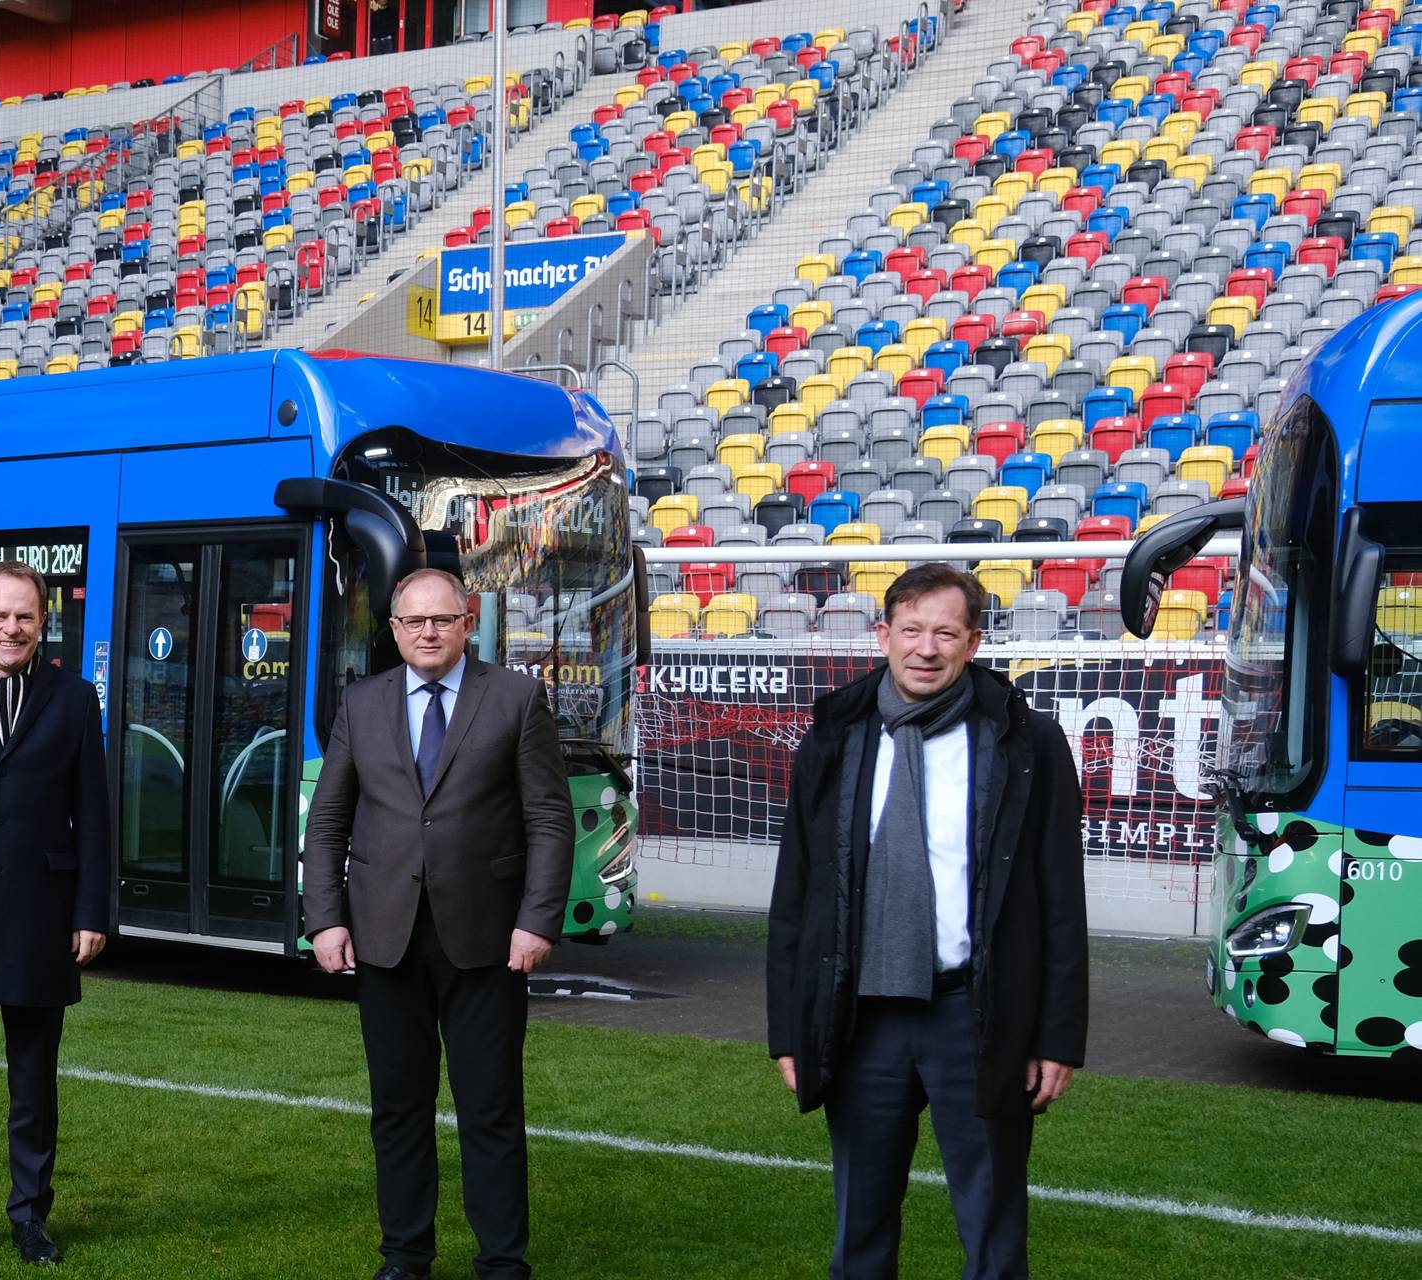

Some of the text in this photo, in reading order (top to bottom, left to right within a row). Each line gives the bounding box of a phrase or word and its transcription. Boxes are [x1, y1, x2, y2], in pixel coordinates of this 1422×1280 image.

[417, 296, 433, 331] 14
[463, 312, 487, 336] 14
[51, 543, 83, 575] 2024
[650, 666, 788, 694] KYOCERA
[1026, 672, 1224, 800] nt
[1347, 860, 1403, 881] 6010
